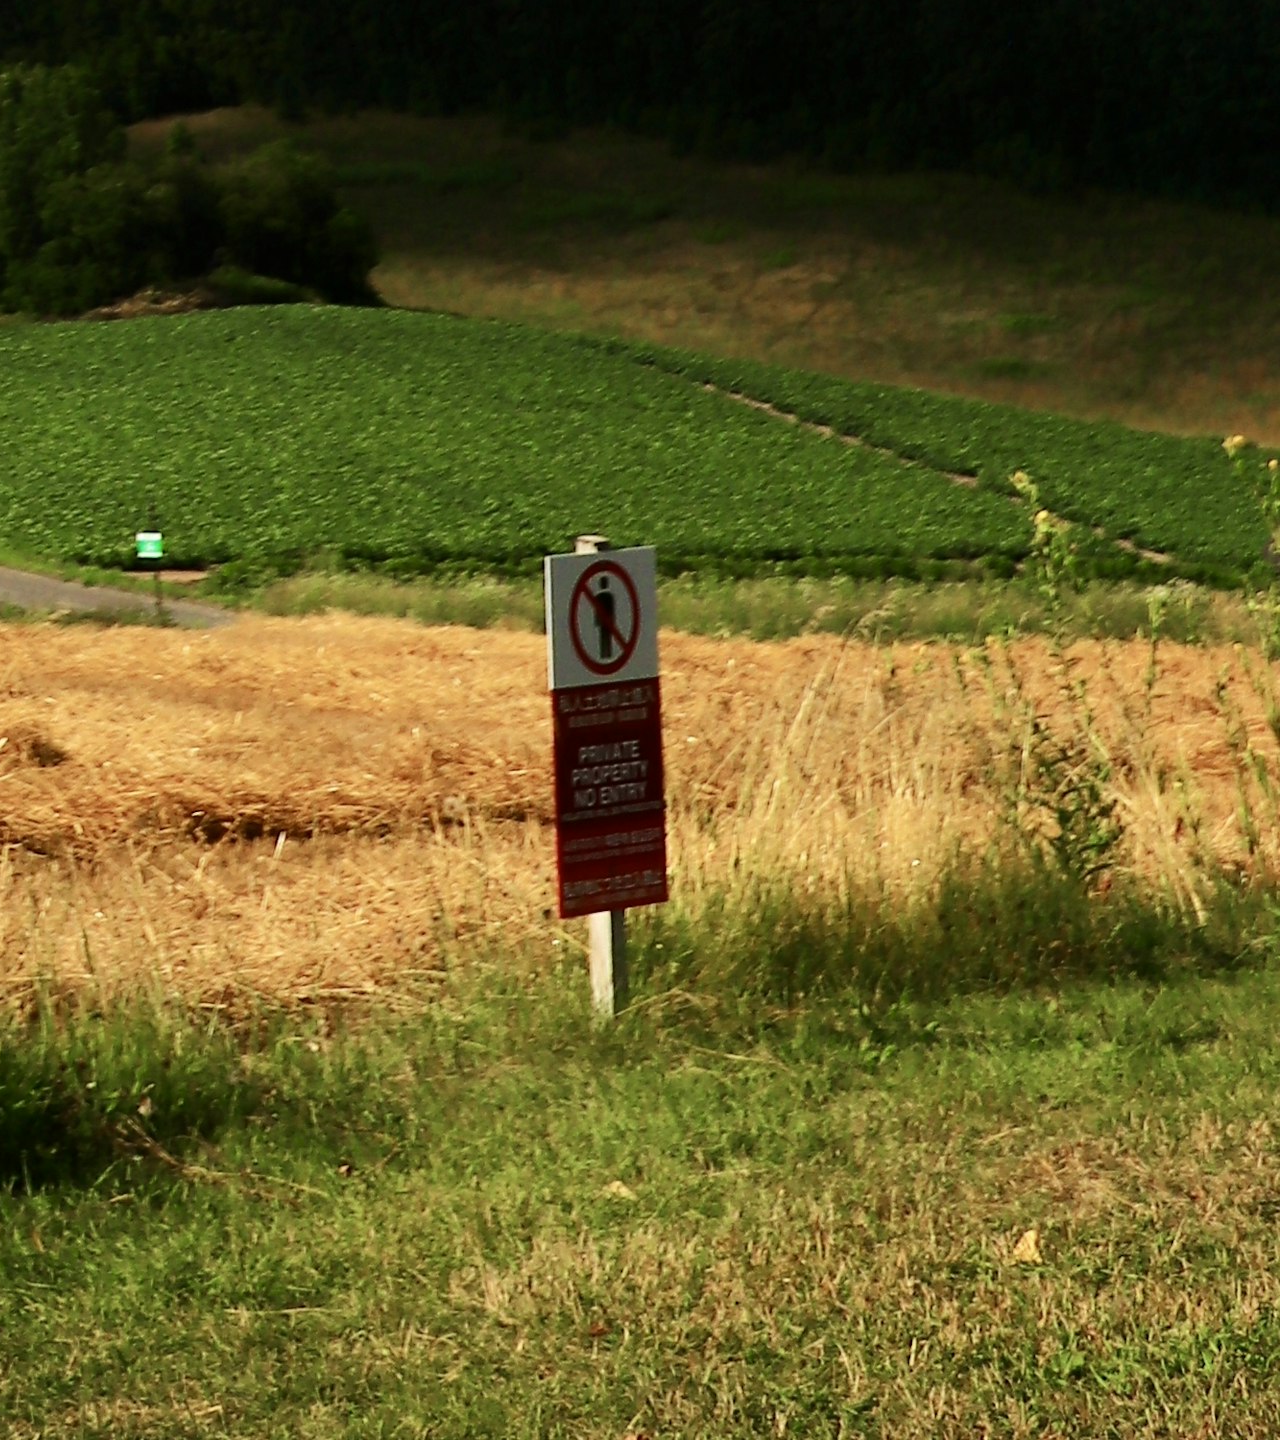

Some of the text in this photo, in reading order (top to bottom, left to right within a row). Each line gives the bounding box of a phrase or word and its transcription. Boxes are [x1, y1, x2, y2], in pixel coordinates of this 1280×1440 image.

[578, 739, 640, 764] PRIVATE
[571, 760, 648, 787] PROPERTY
[575, 782, 646, 807] NO ENTRY
